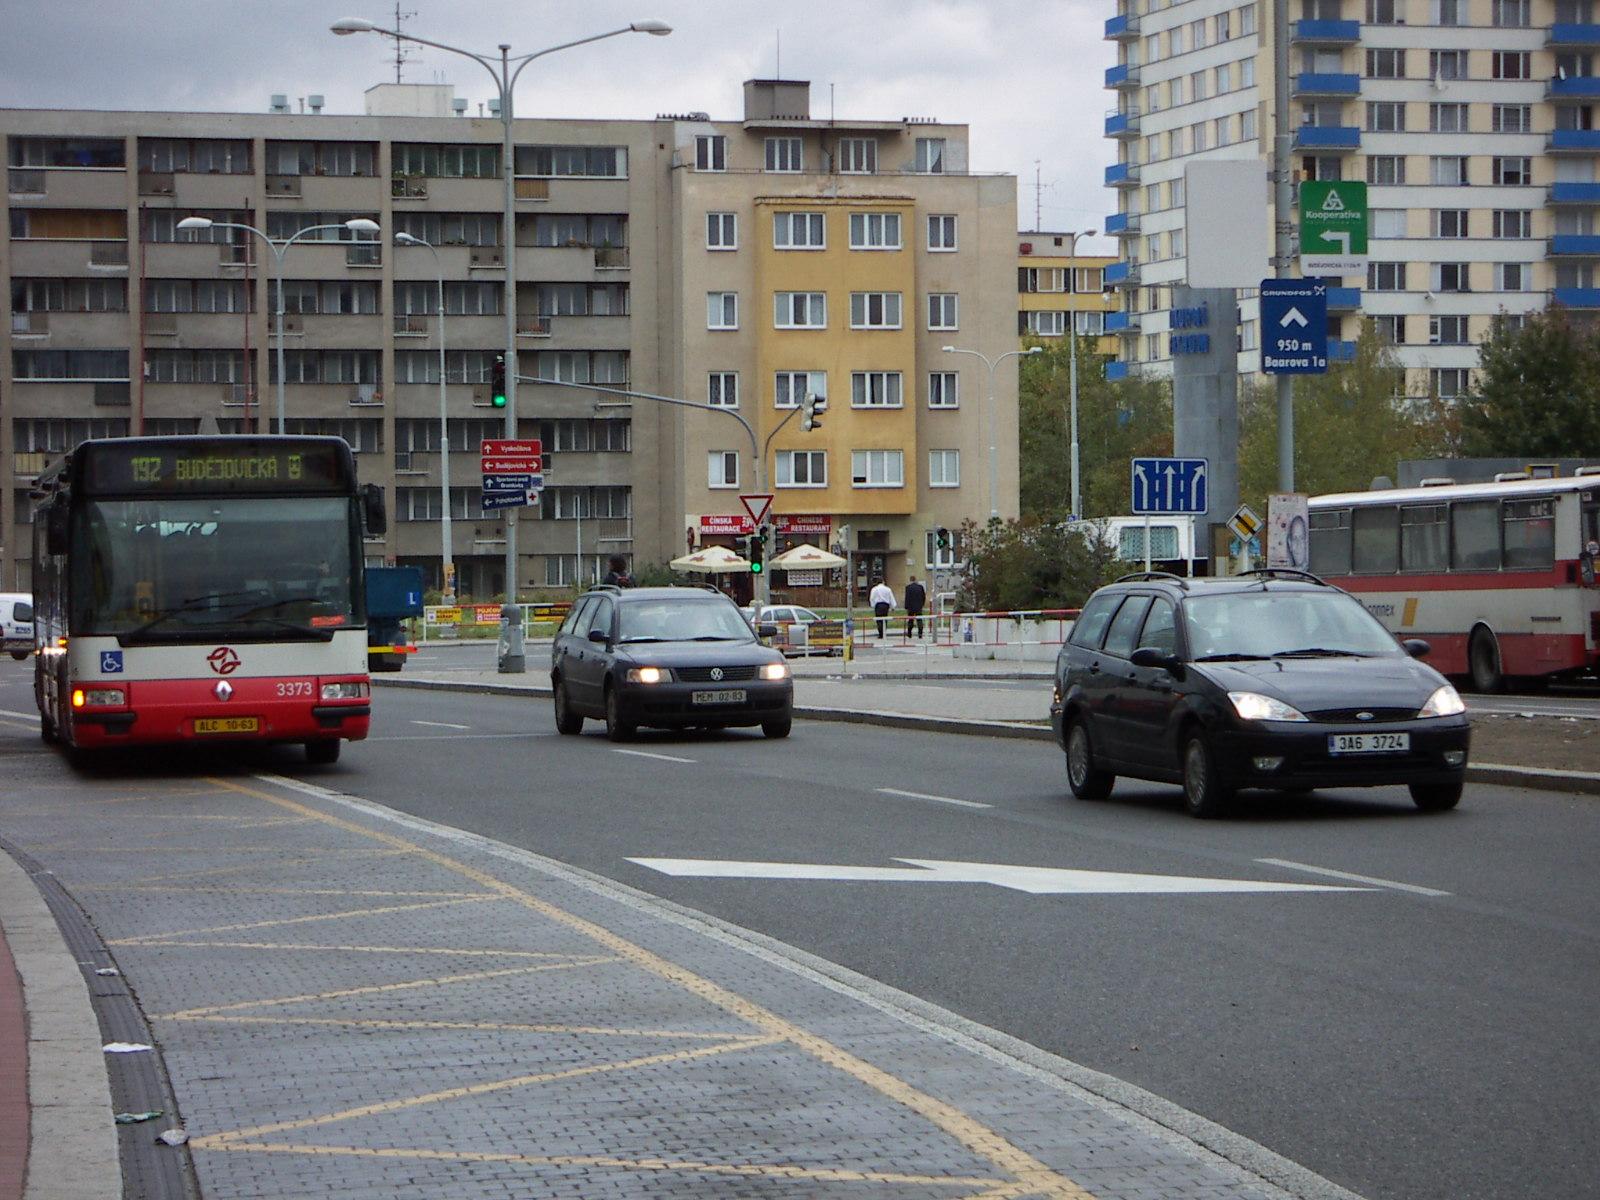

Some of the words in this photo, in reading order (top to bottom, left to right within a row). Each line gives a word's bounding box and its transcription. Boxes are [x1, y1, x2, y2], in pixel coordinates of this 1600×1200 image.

[1306, 210, 1361, 221] Kooperativa
[1277, 340, 1299, 352] 950
[1302, 342, 1312, 351] m
[1264, 356, 1309, 368] Baarova
[1312, 356, 1326, 367] 1a
[131, 456, 162, 481] 192
[701, 525, 740, 533] RESTAURACE
[791, 524, 830, 533] RESTAURANT
[409, 592, 416, 604] L
[276, 682, 312, 696] 3373
[200, 721, 218, 731] ALC
[1340, 737, 1363, 750] 3A6
[1372, 735, 1403, 749] 3724
